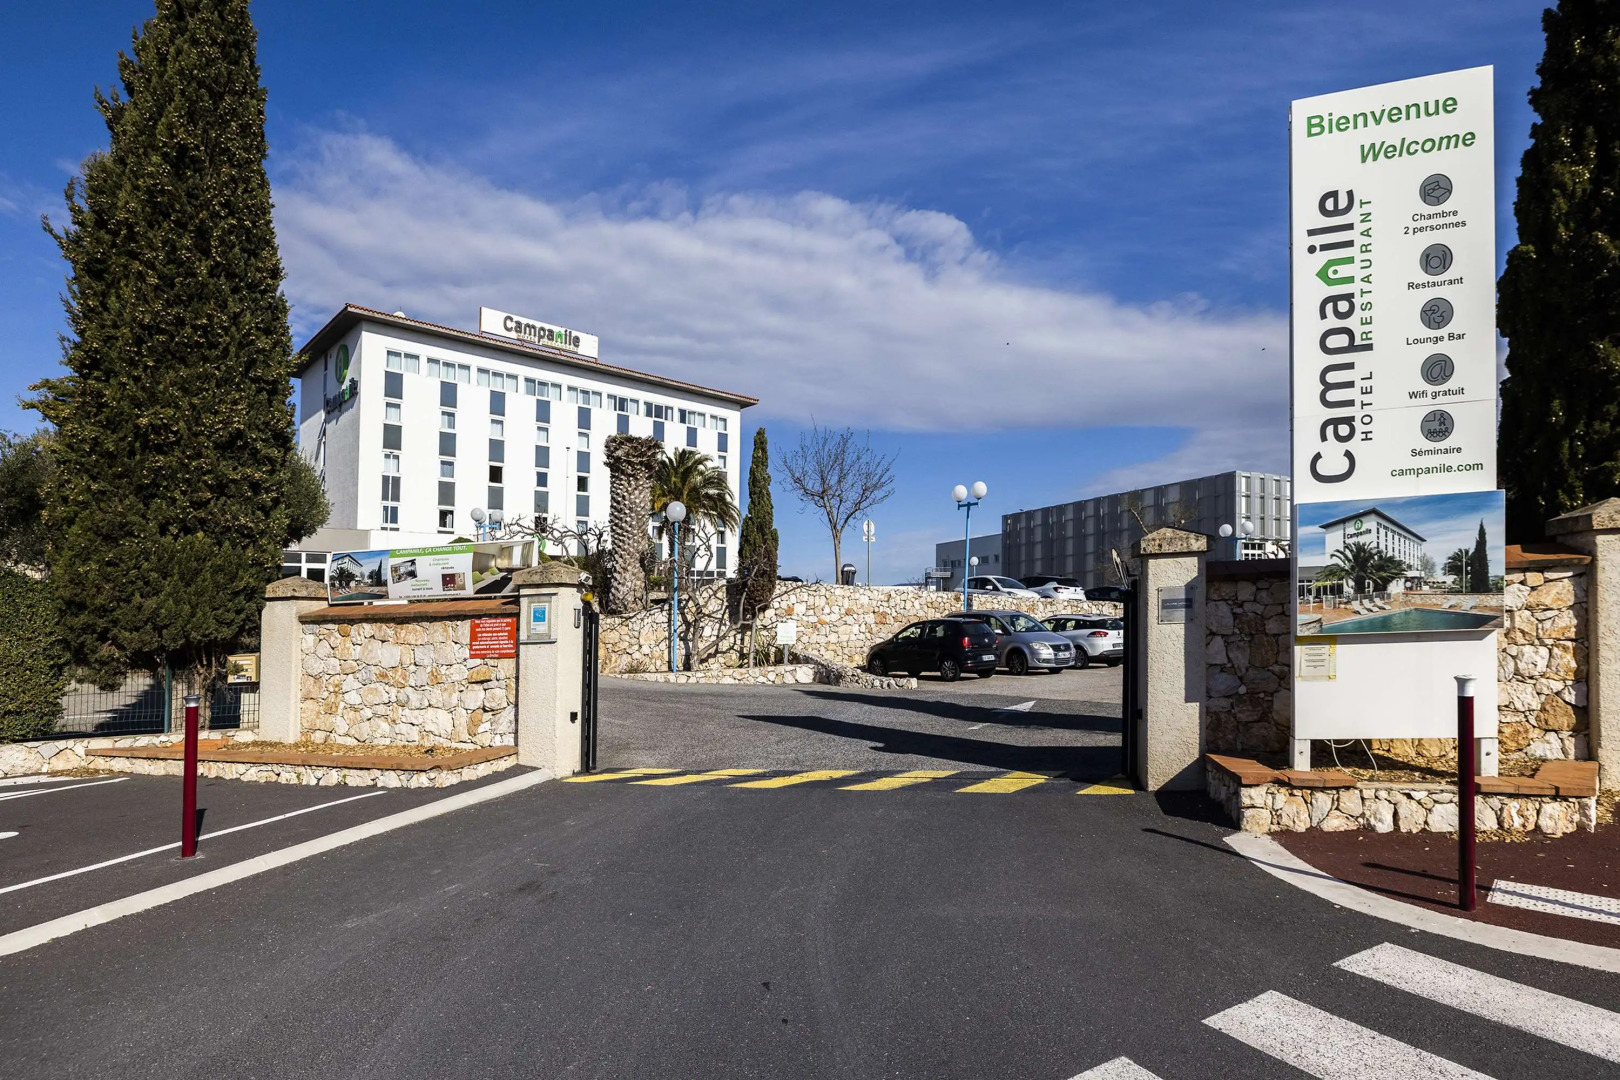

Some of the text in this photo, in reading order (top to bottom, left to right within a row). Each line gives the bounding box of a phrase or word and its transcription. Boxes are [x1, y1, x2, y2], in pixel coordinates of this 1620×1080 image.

[1306, 96, 1458, 138] Bienvenue
[1360, 131, 1476, 164] Welcome
[1411, 208, 1459, 222] Chambre
[1403, 220, 1467, 236] 2 personnes
[1407, 276, 1464, 290] Restaurant
[1359, 199, 1374, 441] HOTEL RESTAURANT
[503, 315, 581, 348] Campanile
[1306, 188, 1374, 484] Campanile
[1406, 331, 1466, 347] Lounge Bar
[1408, 387, 1465, 400] Wifi gratuit
[1410, 445, 1462, 457] Séminaire
[1390, 462, 1484, 478] campanile.com
